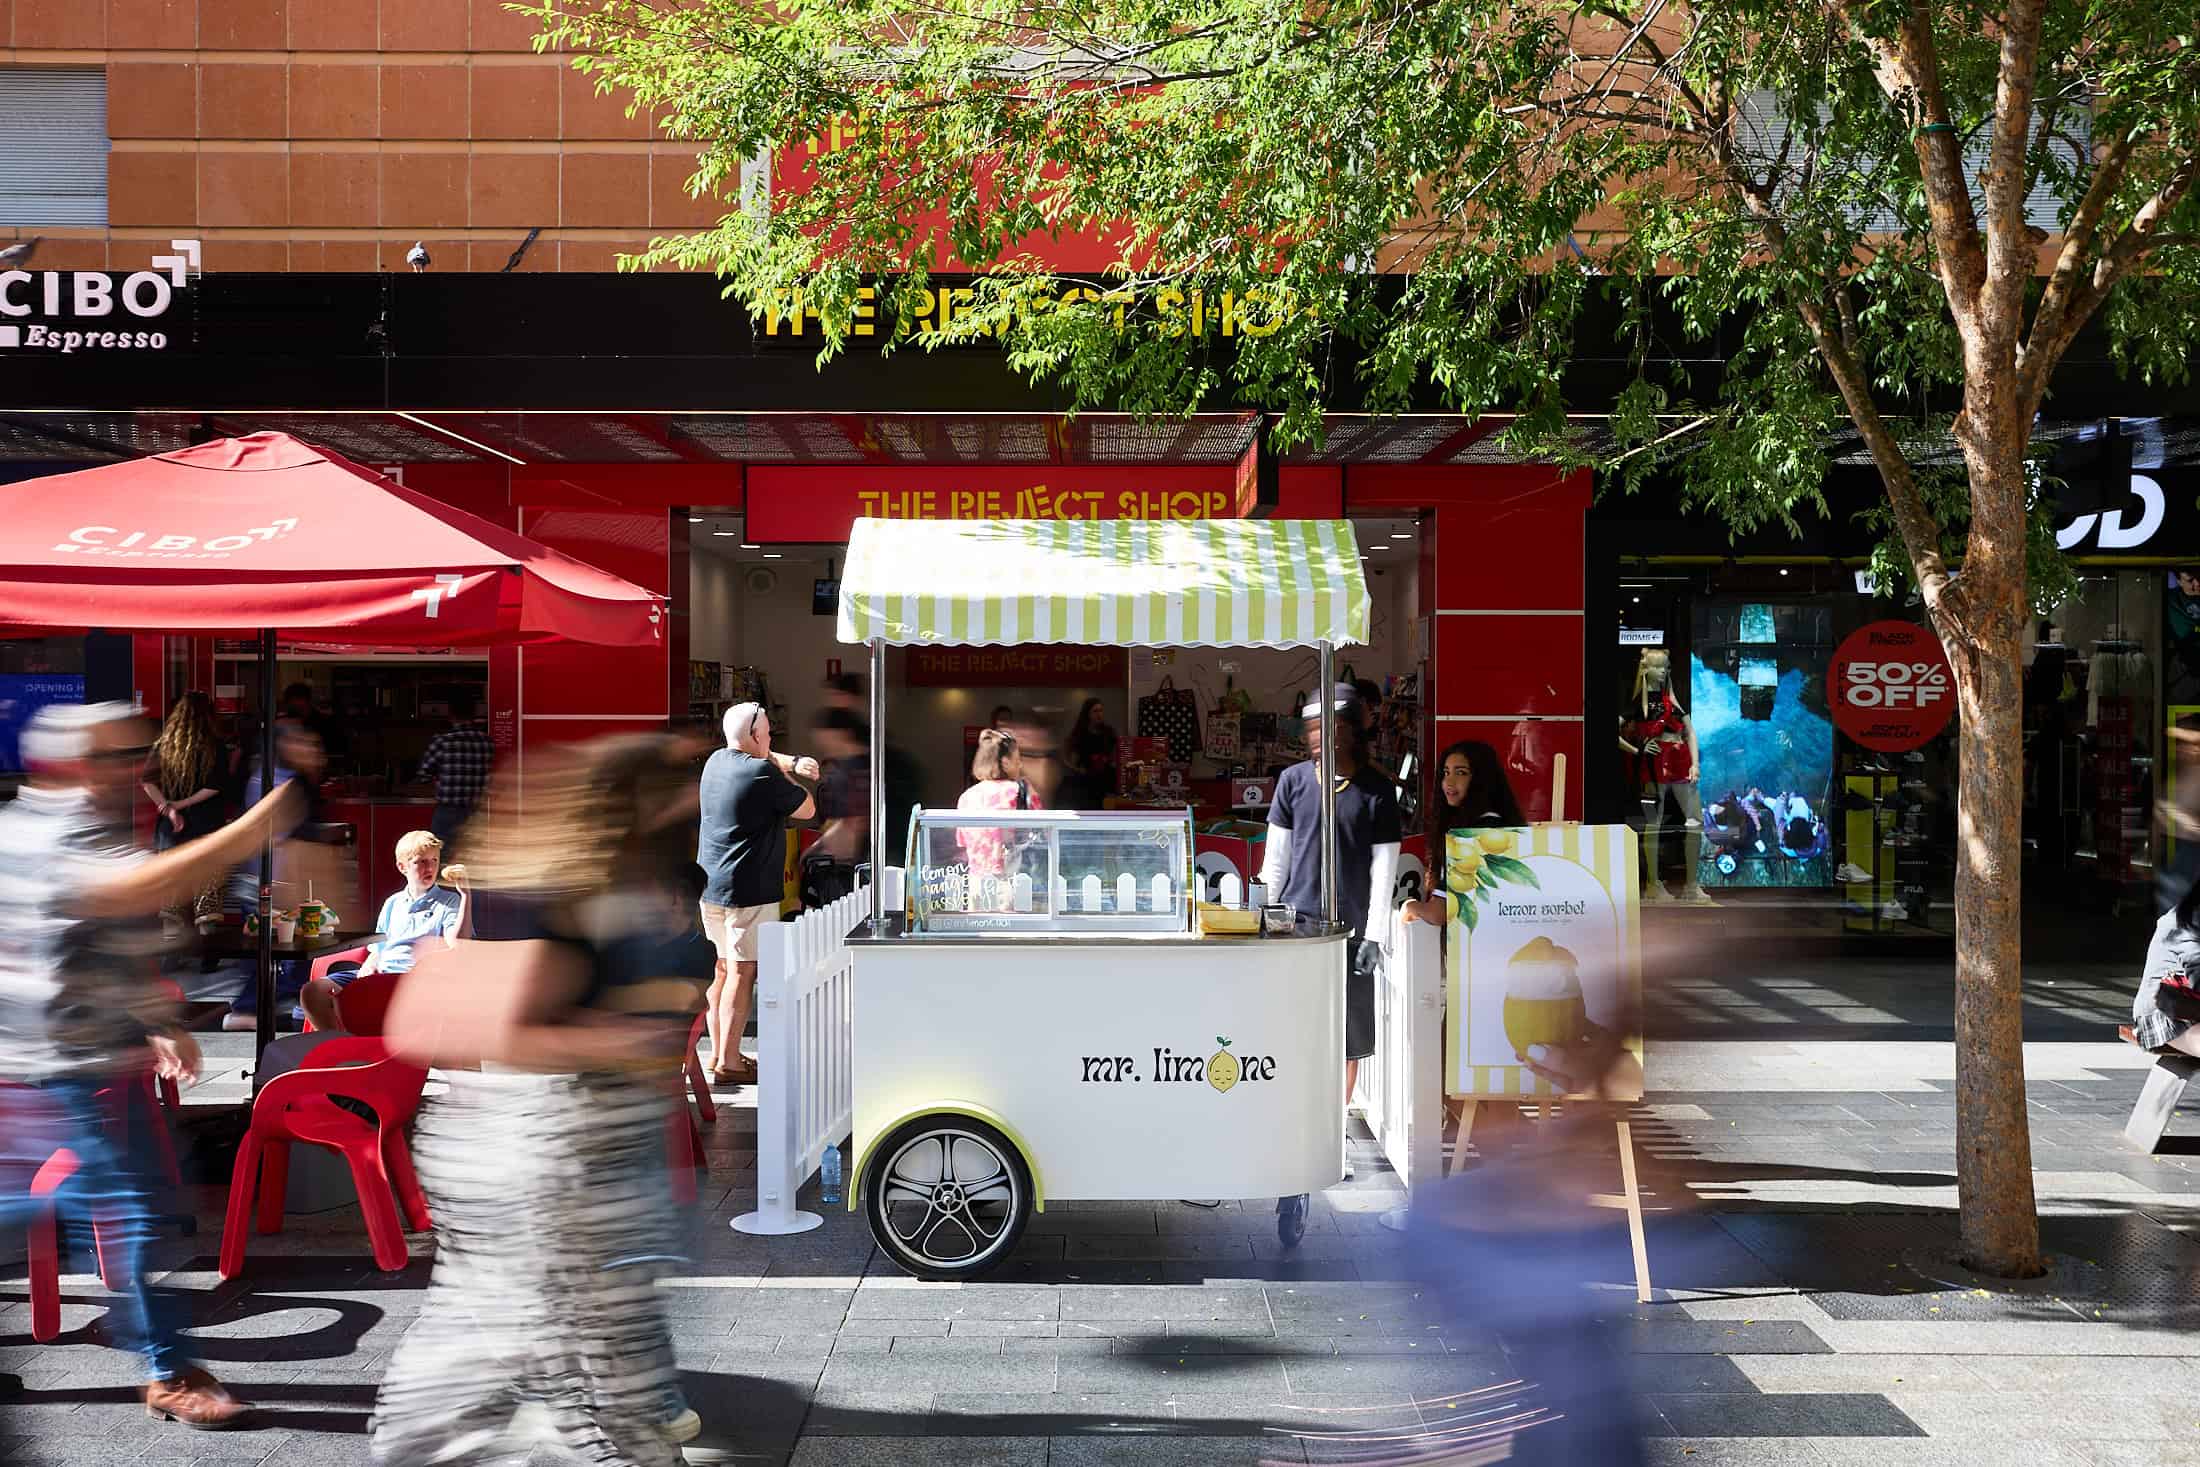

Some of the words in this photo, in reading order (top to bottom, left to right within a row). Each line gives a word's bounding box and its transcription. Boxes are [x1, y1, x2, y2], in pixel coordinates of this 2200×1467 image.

[0, 270, 172, 317] CIBO
[24, 325, 167, 353] Espresso
[858, 491, 936, 519] THE
[951, 484, 1105, 520] REJECT
[1118, 491, 1227, 520] SHOP
[69, 526, 254, 551] CIBO
[920, 655, 961, 672] THE
[1054, 655, 1111, 673] SHOP
[1847, 662, 1947, 685] 50%
[1498, 901, 1537, 916] lemon
[1541, 900, 1586, 916] sorbet
[1081, 1056, 1142, 1082] mr.
